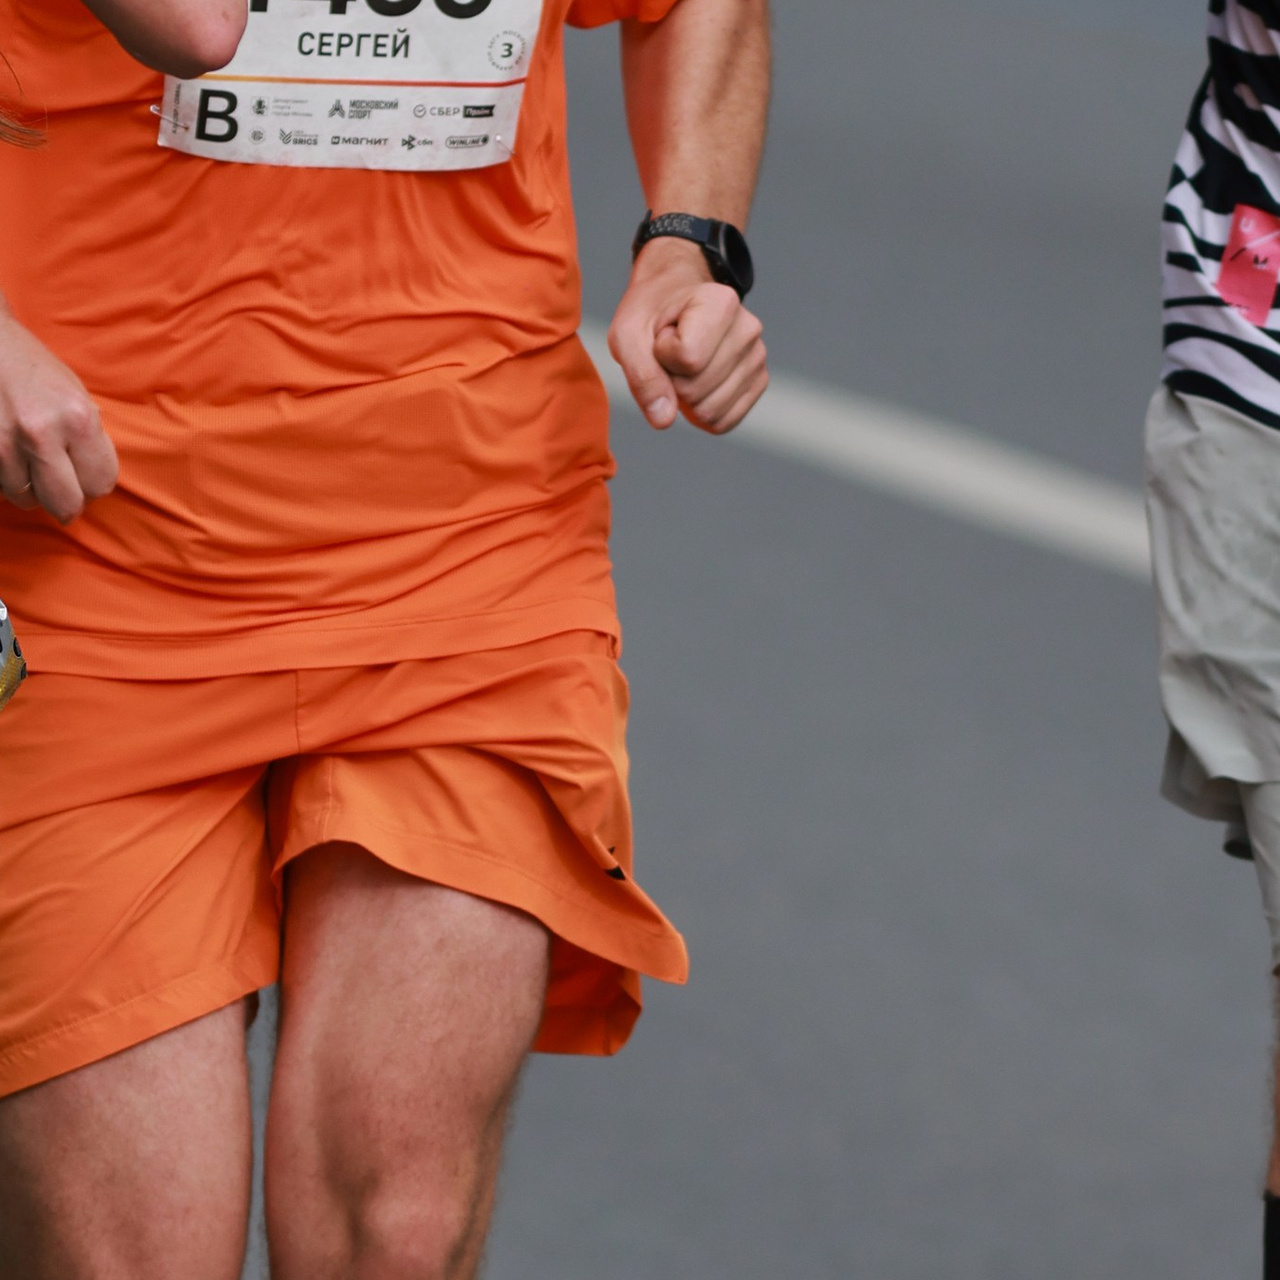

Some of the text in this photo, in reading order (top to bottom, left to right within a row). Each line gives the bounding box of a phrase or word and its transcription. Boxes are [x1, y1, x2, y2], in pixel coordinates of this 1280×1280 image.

[297, 28, 412, 59] СЕРГЕЙ
[499, 41, 514, 59] 3
[348, 97, 400, 111] МОСКОВСКИЙ
[347, 109, 372, 120] СПОРТ
[429, 106, 461, 117] СБЕР
[292, 137, 319, 146] BRICS
